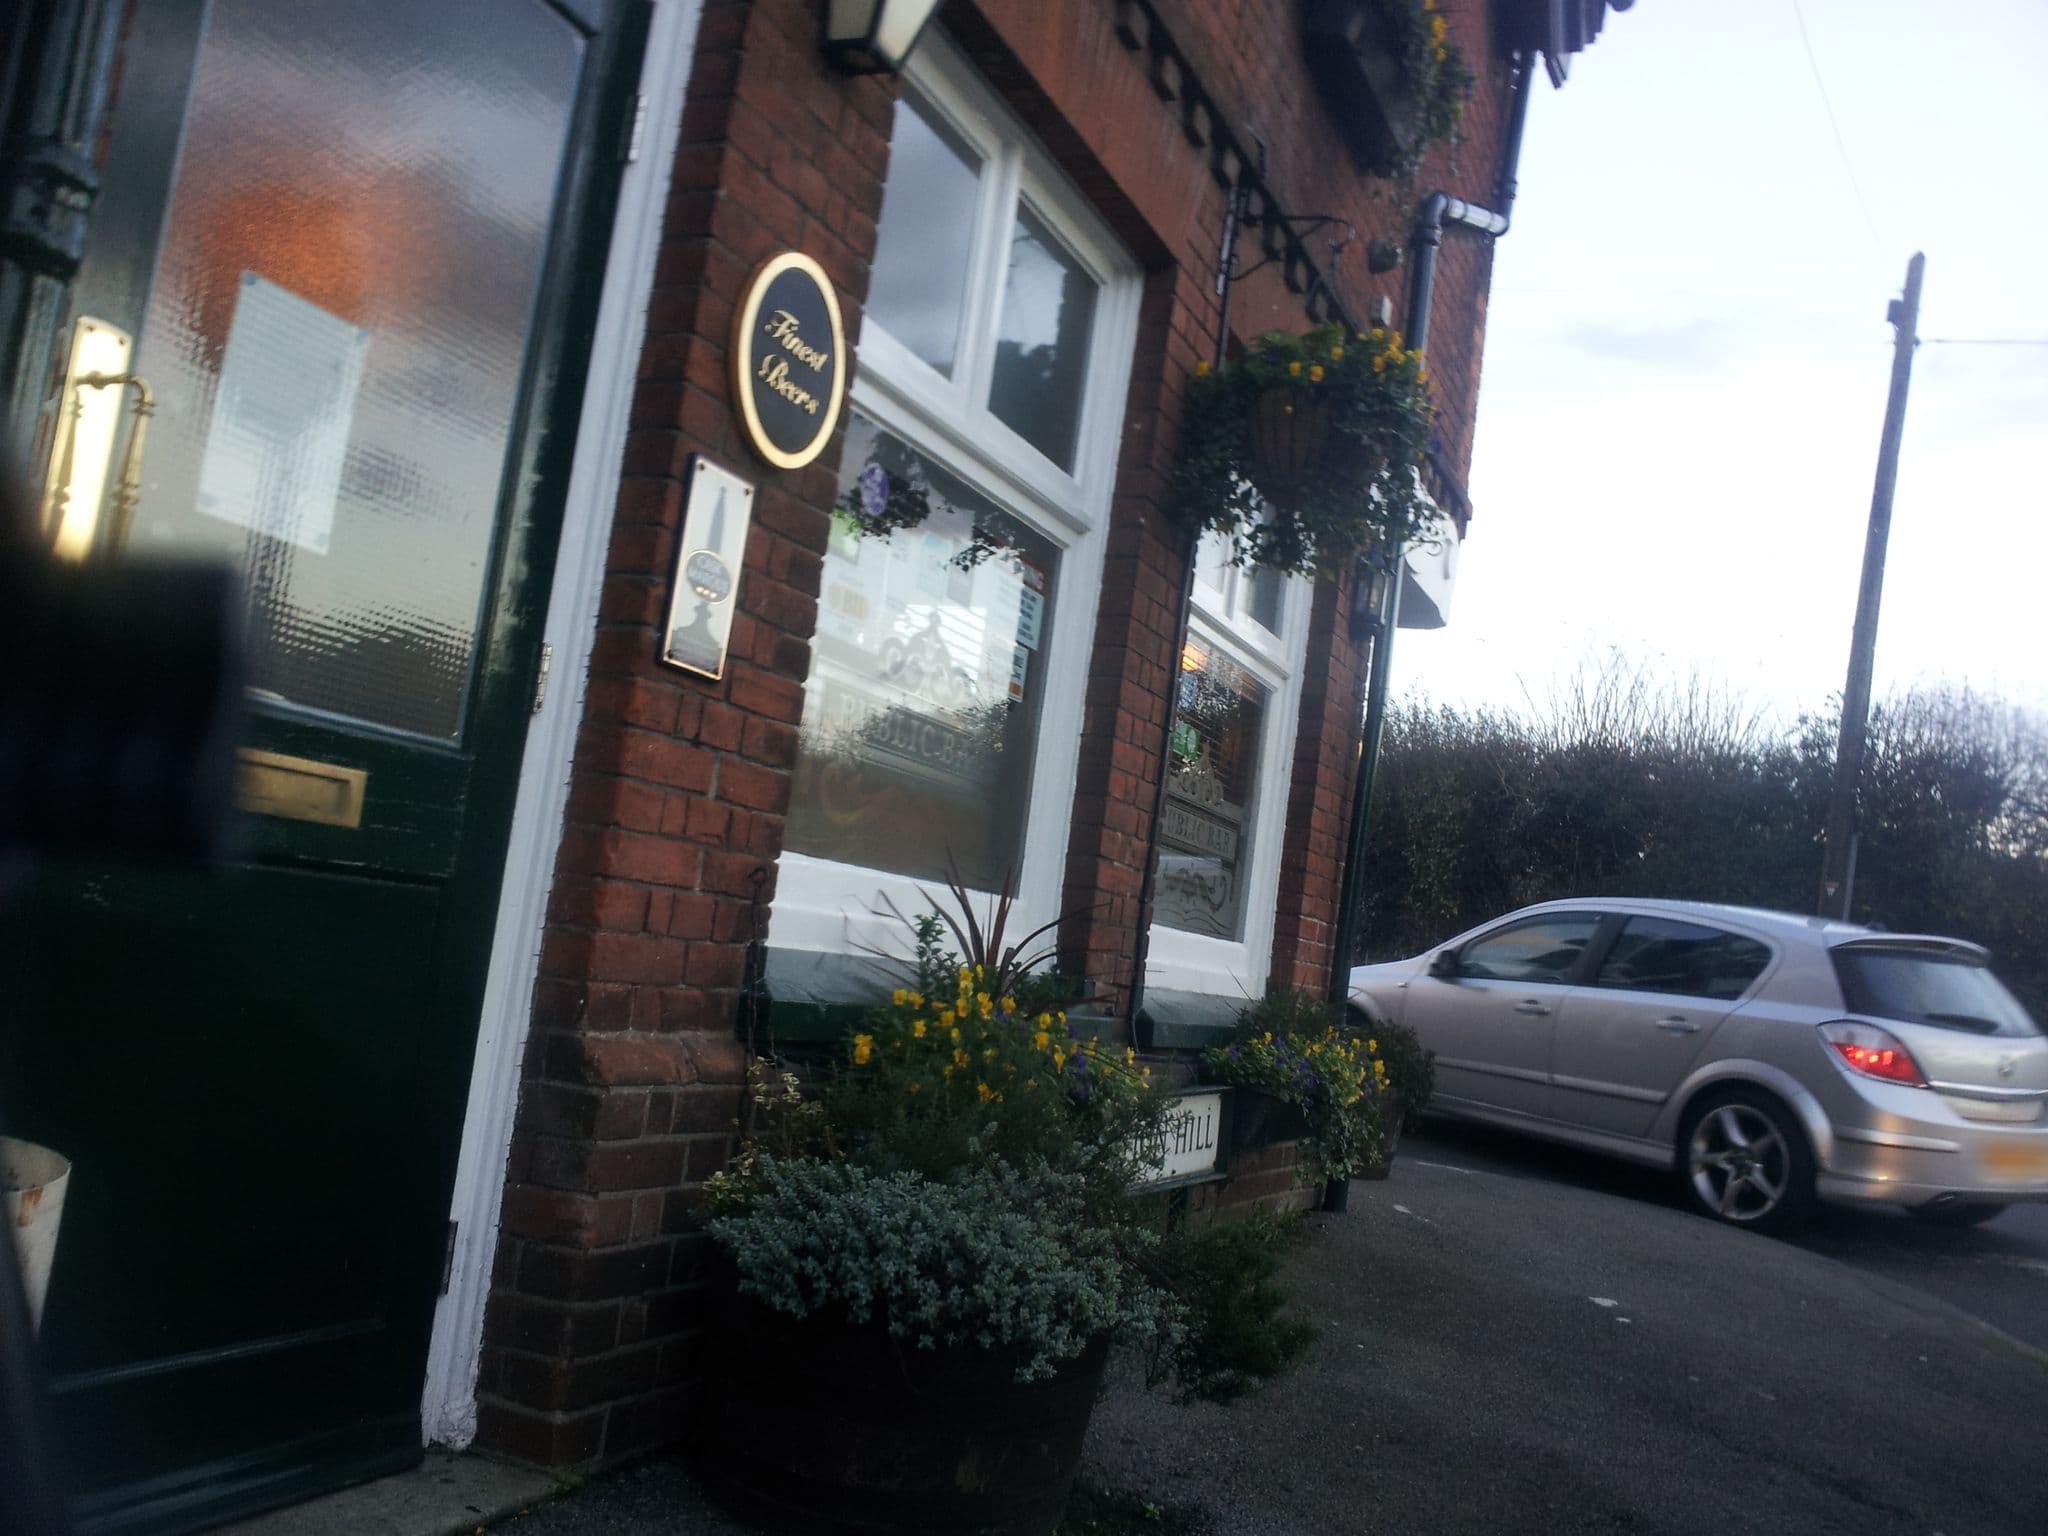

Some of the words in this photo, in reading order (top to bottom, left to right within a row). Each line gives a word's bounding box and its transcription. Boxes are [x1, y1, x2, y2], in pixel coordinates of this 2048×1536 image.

[764, 310, 828, 373] Finest
[758, 354, 819, 415] Beers
[1166, 809, 1204, 846] UBLIC
[1174, 1114, 1213, 1155] HILL
